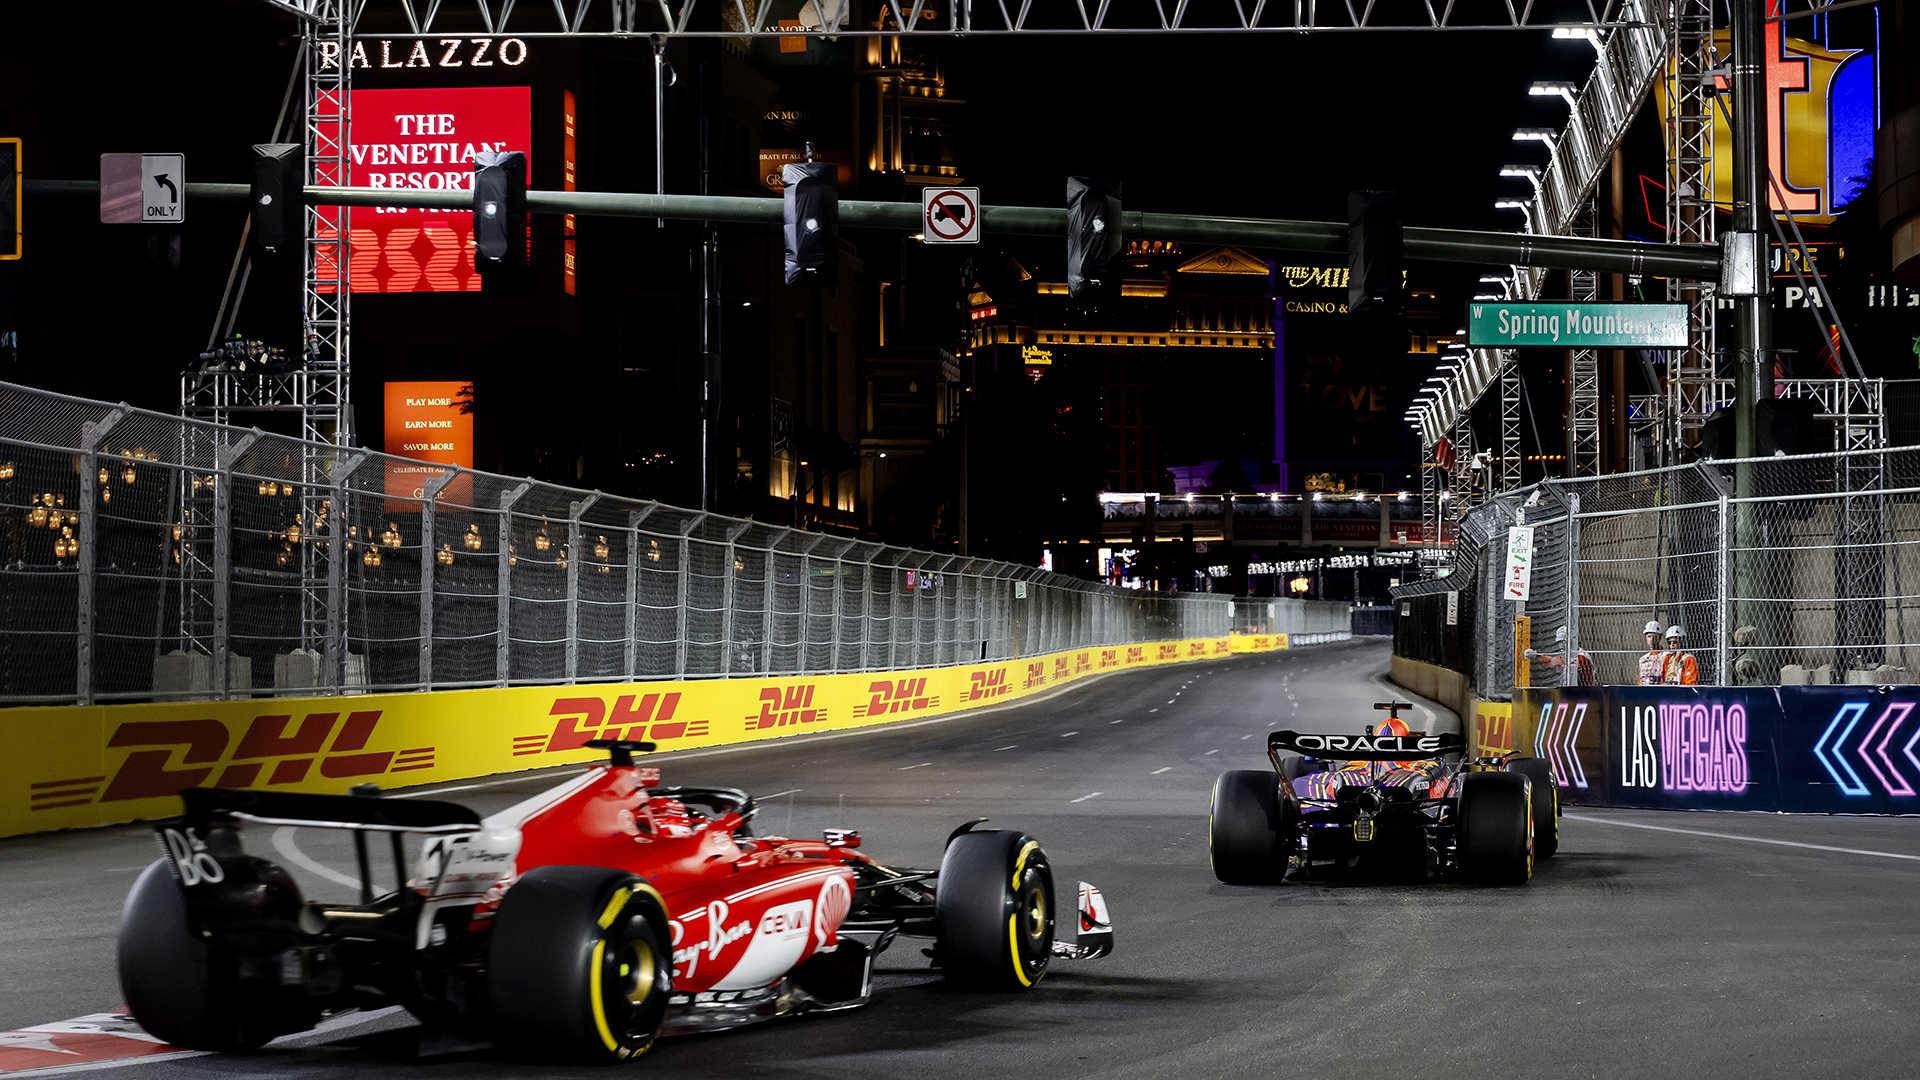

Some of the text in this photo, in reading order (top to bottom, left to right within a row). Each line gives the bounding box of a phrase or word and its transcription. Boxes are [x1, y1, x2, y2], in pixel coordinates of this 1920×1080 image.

[320, 38, 528, 69] PALAZZO
[396, 114, 456, 135] THE
[369, 172, 475, 190] RESORT
[147, 206, 176, 217] ONLY
[1286, 302, 1348, 313] CASINO &
[1473, 306, 1483, 319] W
[1498, 309, 1559, 342] Spring
[1566, 310, 1651, 334] Mountain
[428, 398, 451, 406] MORE
[430, 443, 454, 451] MORE
[969, 668, 1007, 700] DHL
[1027, 662, 1045, 688] DHL
[757, 685, 818, 730] DHL
[867, 677, 930, 717] DHL
[545, 692, 682, 753] DHL
[1295, 735, 1440, 751] ORACLE
[1621, 704, 1748, 792] LAS VEGAS
[99, 710, 394, 803] DHL
